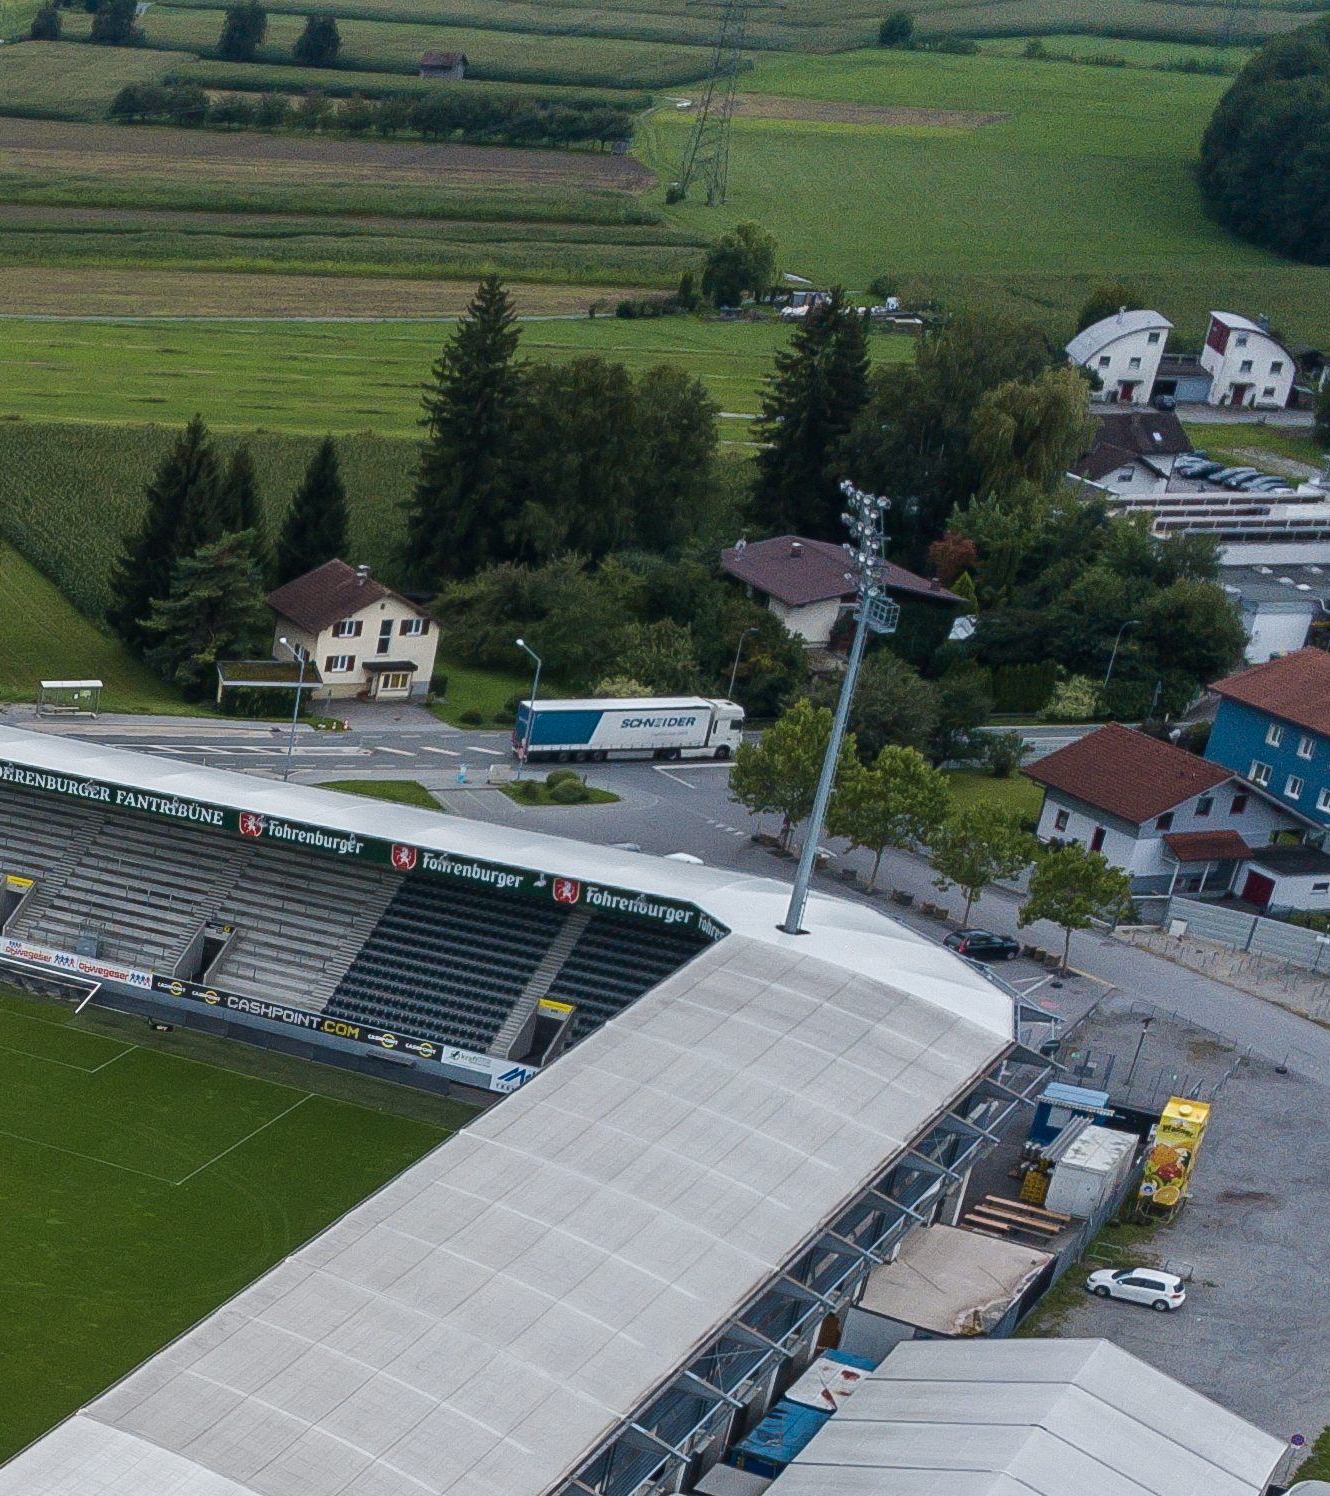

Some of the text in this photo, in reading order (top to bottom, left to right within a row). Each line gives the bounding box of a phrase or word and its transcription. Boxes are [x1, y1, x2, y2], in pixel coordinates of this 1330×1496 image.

[115, 790, 224, 826] FANTRIBÜNE
[268, 819, 364, 855] Fohrenburger
[586, 886, 694, 924] Fohrenburger
[5, 945, 52, 963] obwegeser
[78, 961, 129, 981] obwegeser
[227, 996, 360, 1039] CASHPOINT.COM
